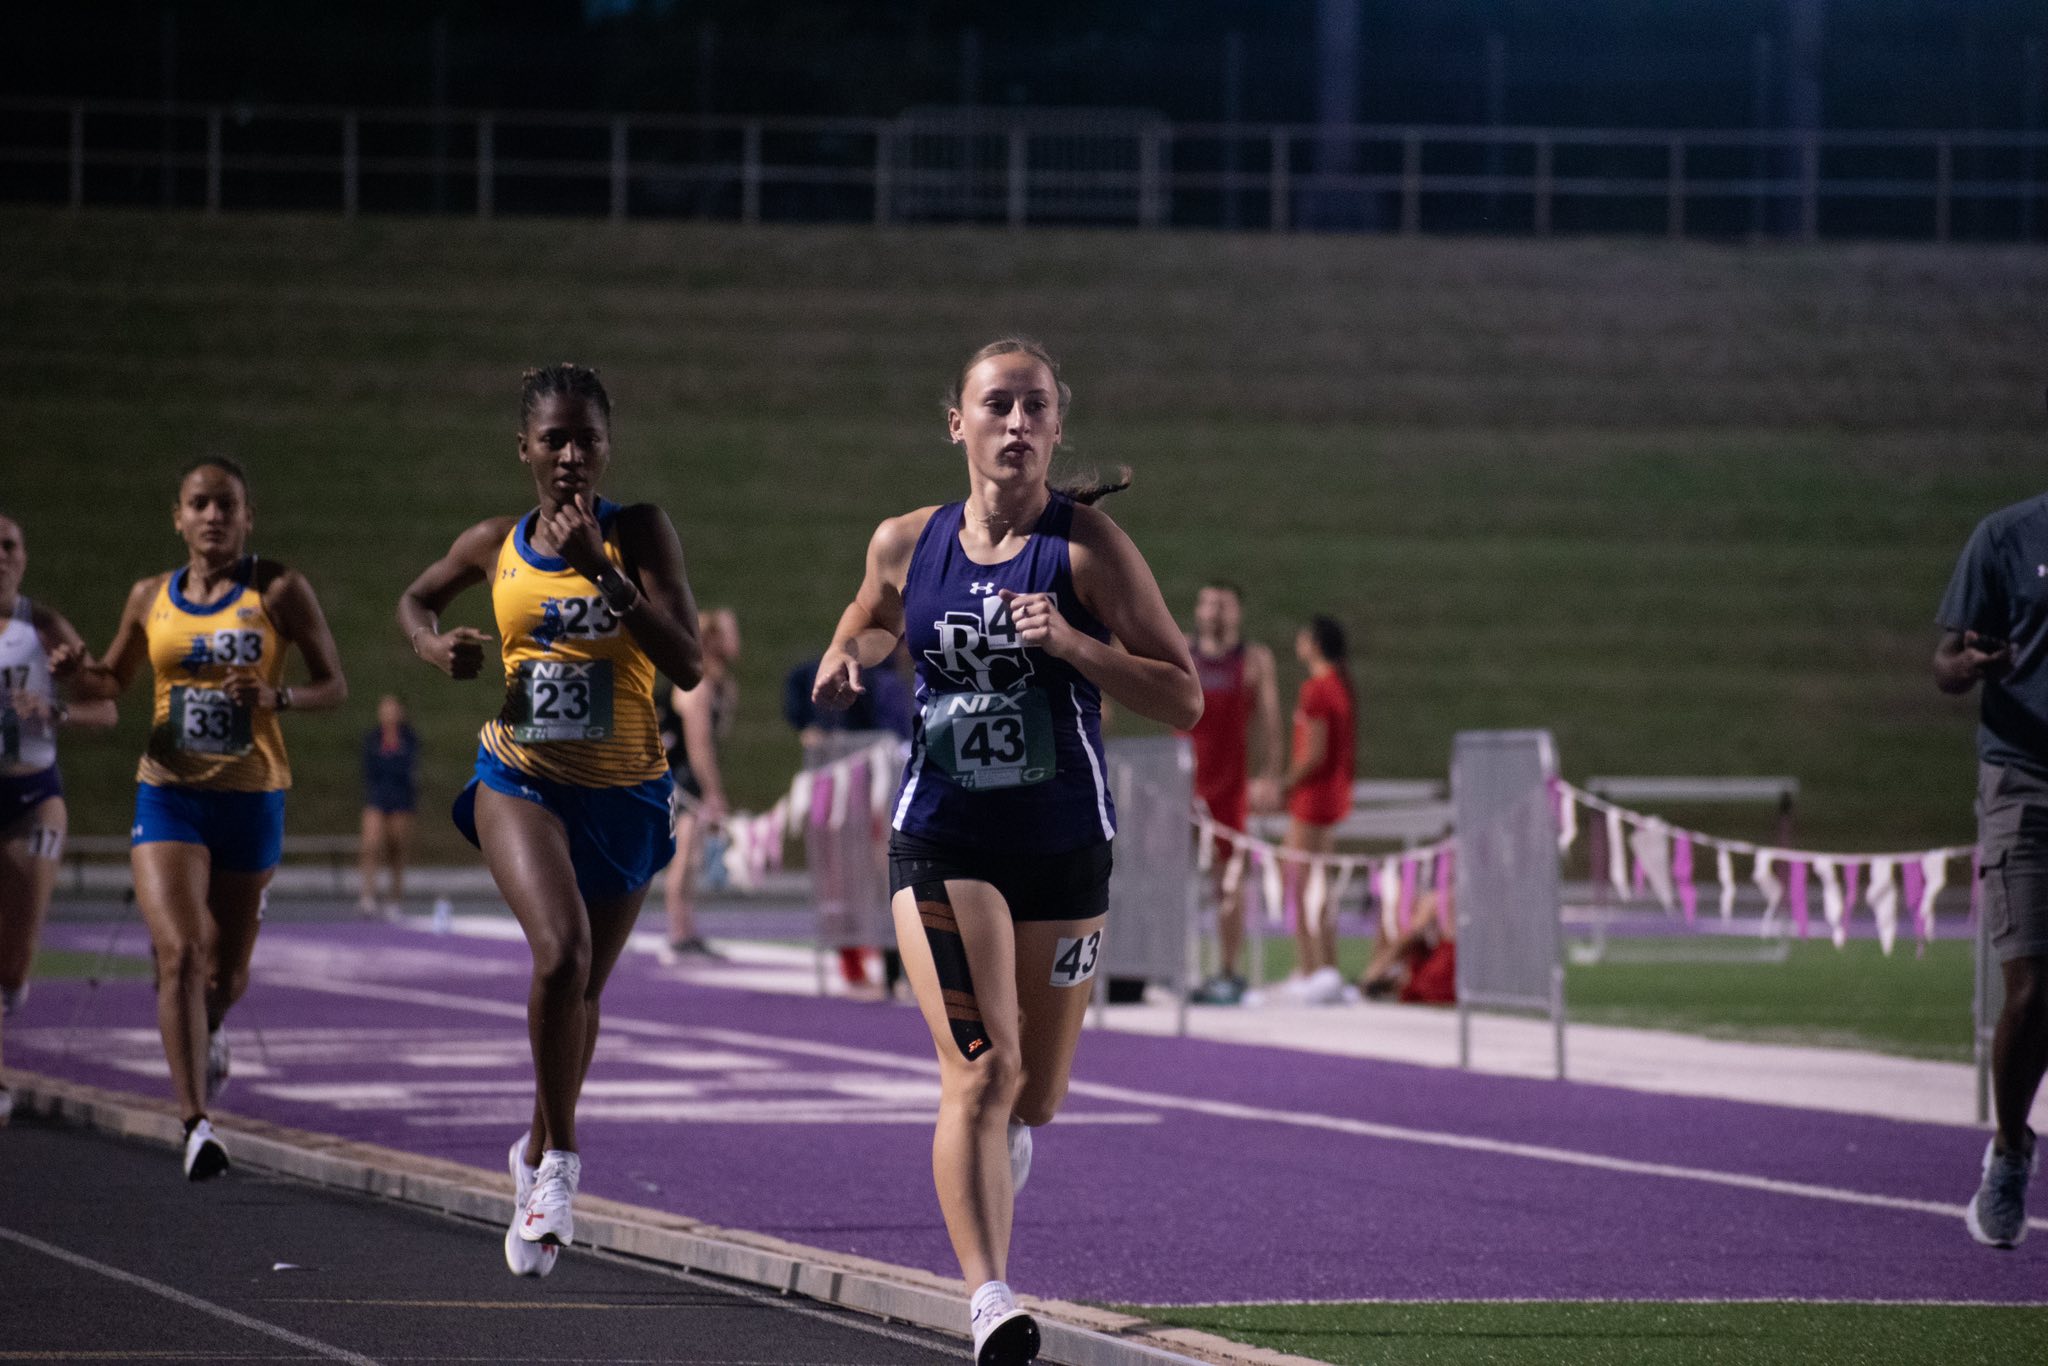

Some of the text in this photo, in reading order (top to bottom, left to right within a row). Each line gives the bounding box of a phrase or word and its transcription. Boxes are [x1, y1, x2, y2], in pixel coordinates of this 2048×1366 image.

[564, 598, 618, 634] 23
[218, 632, 263, 663] 33
[534, 682, 589, 720] 23
[947, 691, 1028, 715] NTX
[189, 708, 231, 740] 33
[961, 717, 1025, 767] 43
[1054, 930, 1101, 981] 43
